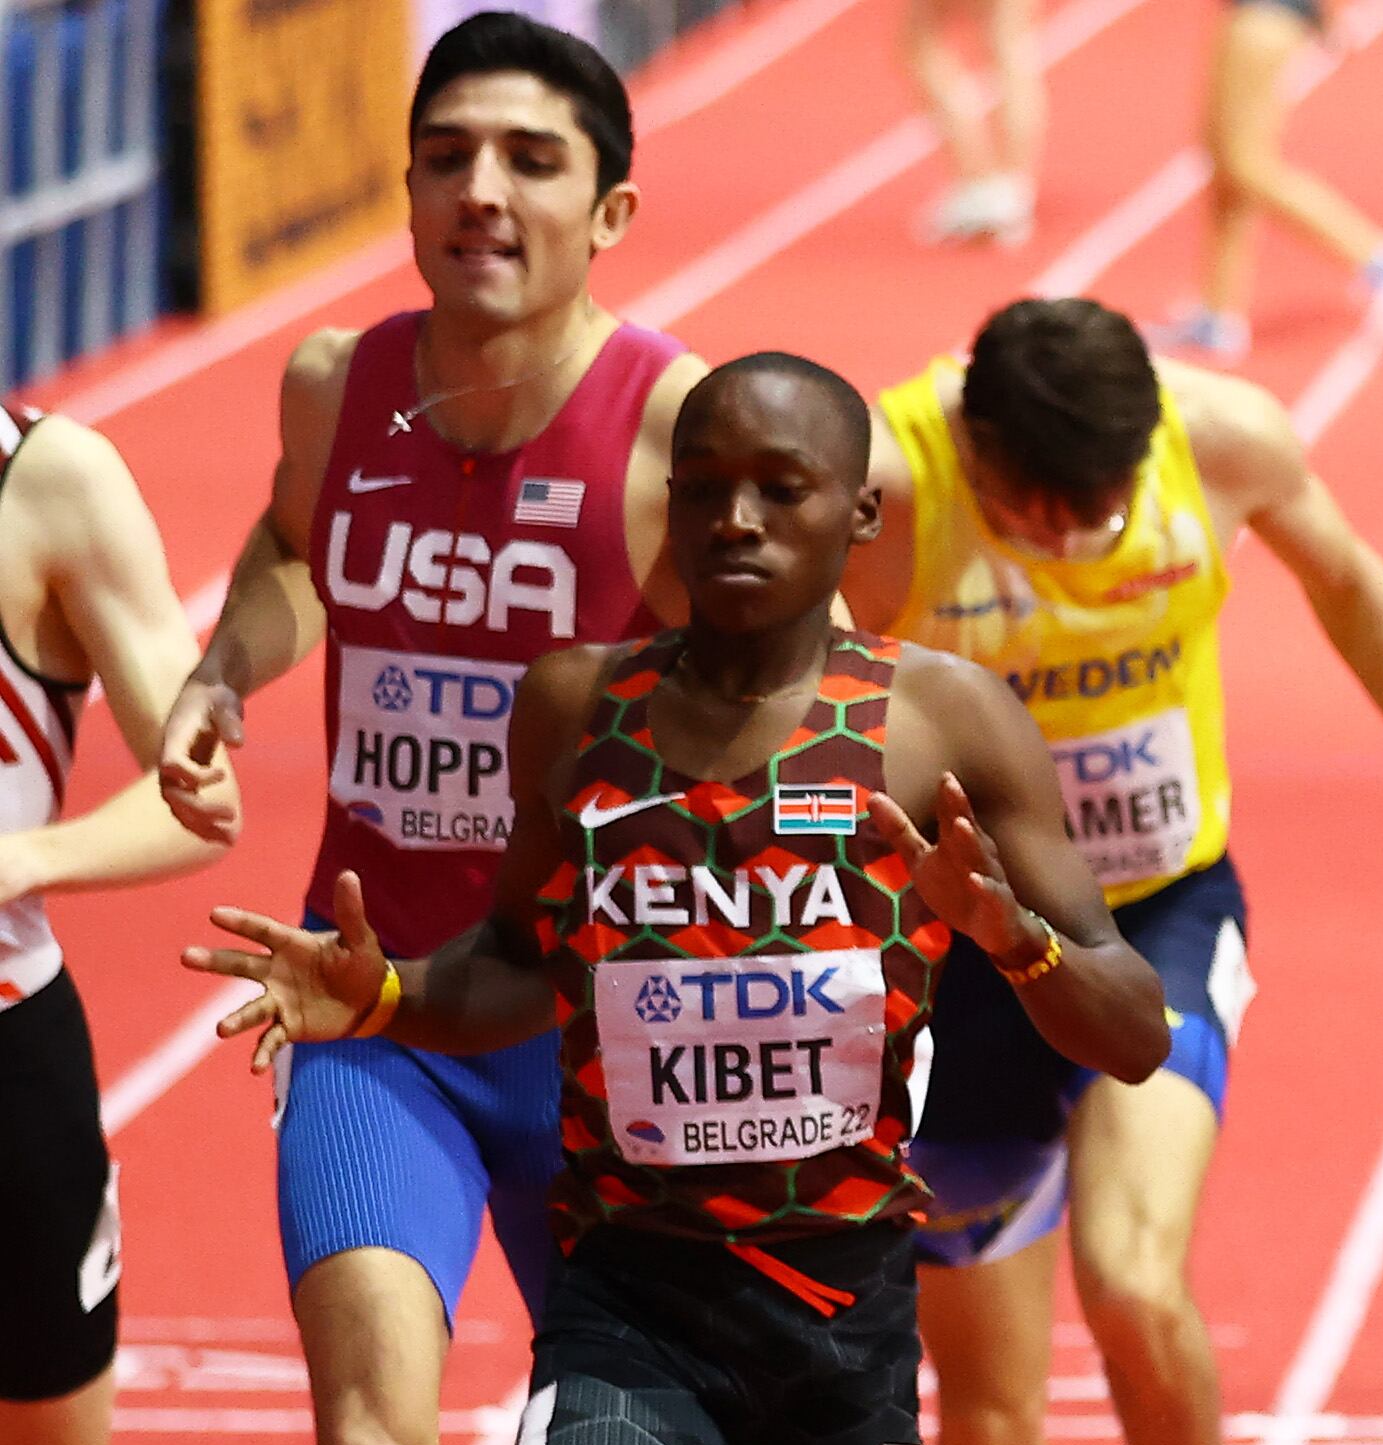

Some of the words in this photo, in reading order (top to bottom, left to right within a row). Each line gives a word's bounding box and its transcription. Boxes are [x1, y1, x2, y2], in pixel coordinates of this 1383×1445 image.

[327, 511, 577, 638] USA
[414, 669, 523, 719] TD
[353, 729, 502, 797] HOPP
[1064, 780, 1186, 841] MER
[585, 864, 854, 929] KENYA
[681, 966, 846, 1021] TDK
[650, 1038, 834, 1105] KIBET
[683, 1112, 834, 1153] BELGRADE
[840, 1103, 870, 1137] 22
